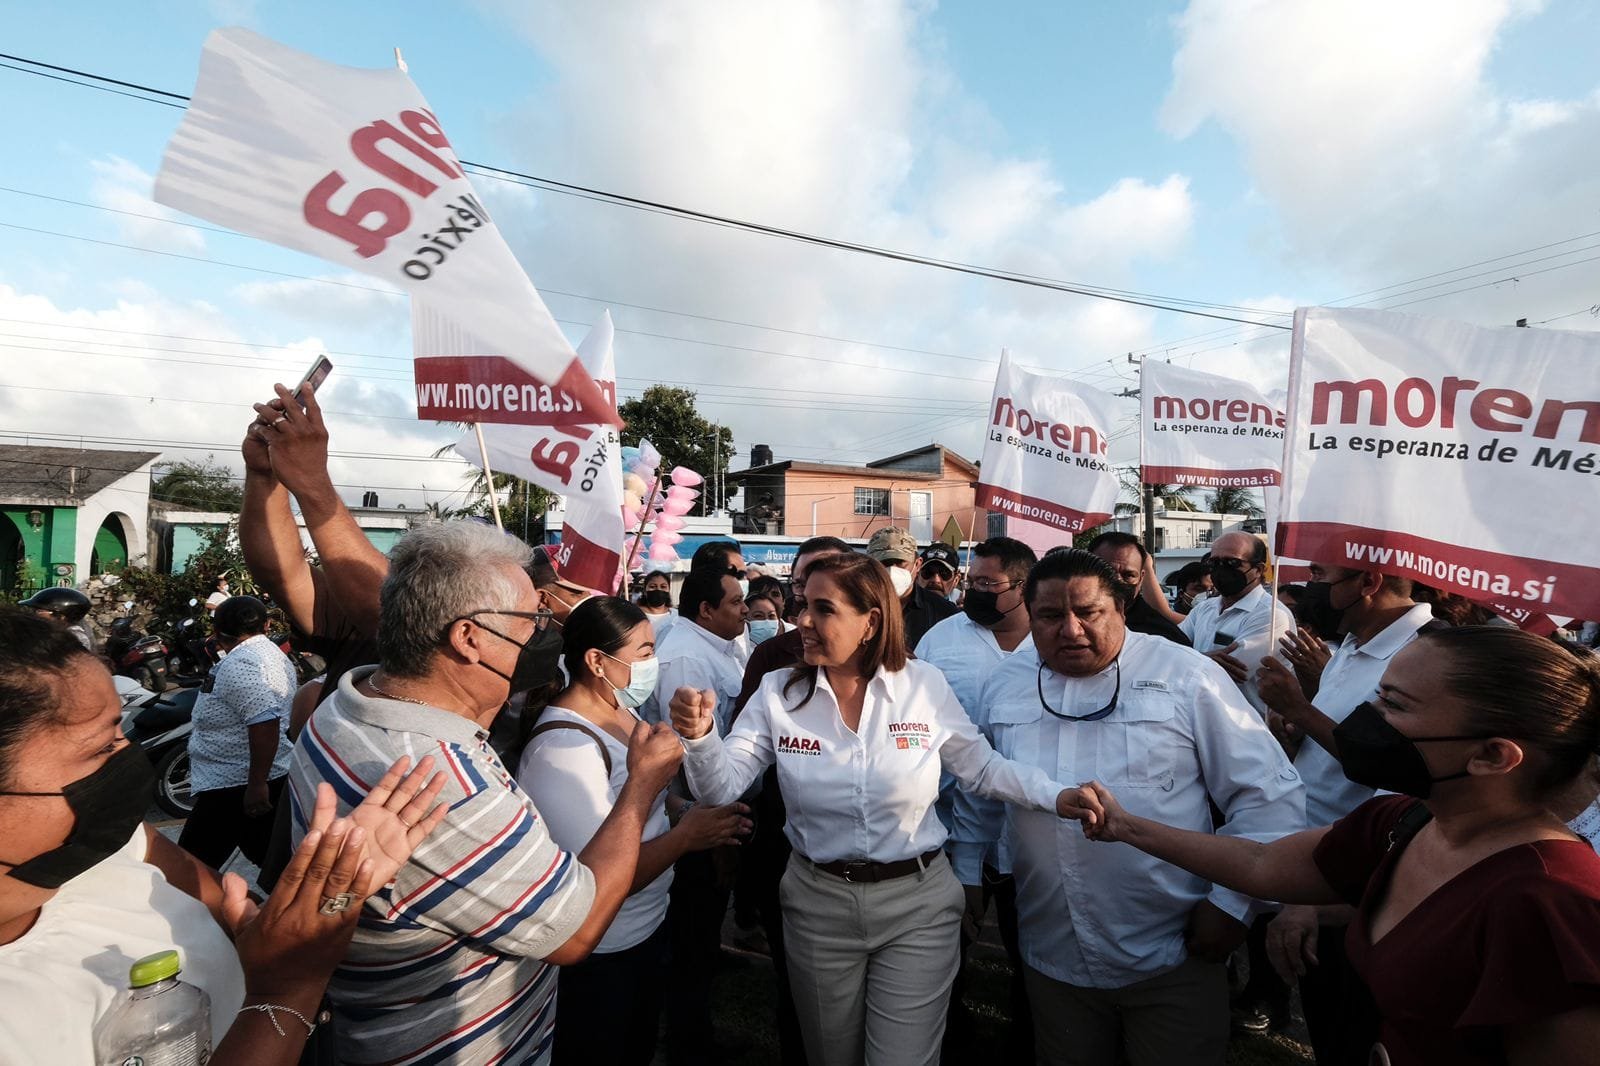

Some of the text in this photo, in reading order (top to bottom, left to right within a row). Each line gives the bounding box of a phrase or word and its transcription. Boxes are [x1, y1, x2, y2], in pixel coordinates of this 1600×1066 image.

[1154, 422, 1167, 432] La
[1171, 423, 1228, 435] esperanza
[1232, 425, 1247, 436] de
[990, 429, 1003, 442] La
[1056, 451, 1071, 464] de
[1308, 432, 1338, 450] La
[1349, 435, 1469, 460] esperanza
[1477, 438, 1518, 463] de
[1175, 474, 1275, 487] www.morena.si
[991, 495, 1085, 531] www.morena.si
[765, 549, 798, 561] Abarr
[1345, 541, 1557, 603] www.morena.si
[889, 722, 930, 733] morena
[778, 735, 821, 751] MARA
